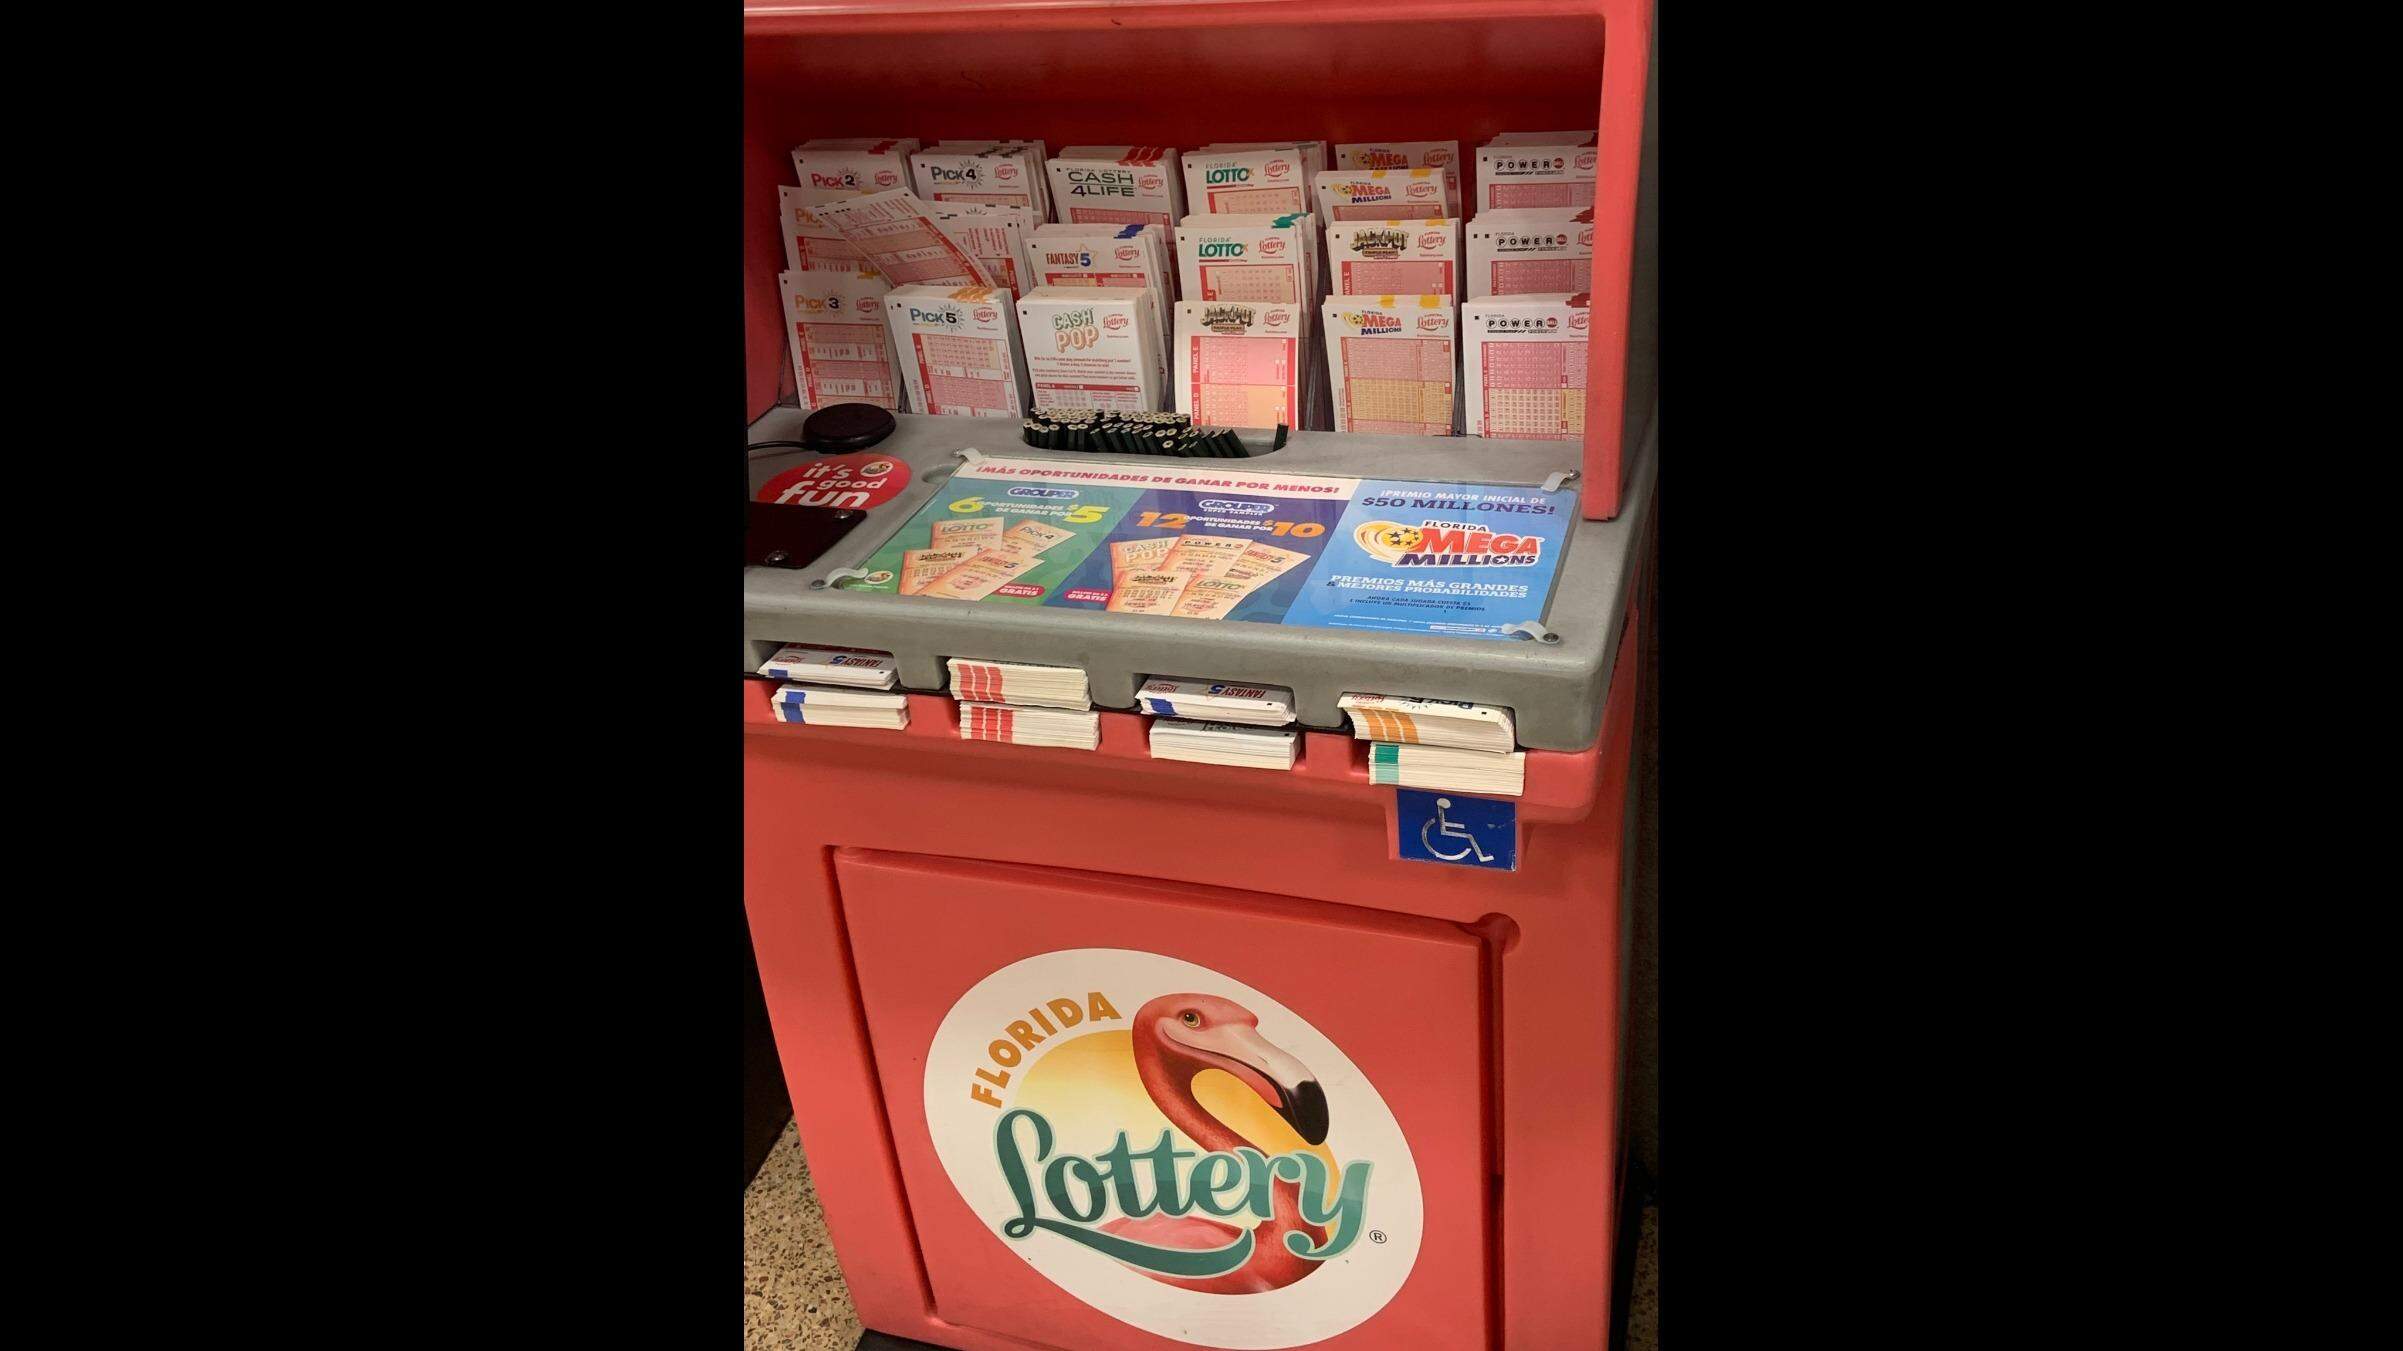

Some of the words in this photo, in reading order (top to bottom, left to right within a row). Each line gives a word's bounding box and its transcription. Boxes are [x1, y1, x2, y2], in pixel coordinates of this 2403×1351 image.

[1370, 153, 1408, 167] MEGA
[845, 175, 856, 186] 2
[965, 168, 976, 180] 4
[1068, 171, 1135, 185] CASH
[1206, 168, 1250, 184] LOTTO
[1070, 185, 1135, 198] 4LIFE
[1352, 184, 1391, 196] MEGA
[1198, 242, 1245, 258] LOTTO
[1046, 253, 1079, 265] FANTASY
[1080, 253, 1092, 267] 5
[828, 297, 839, 309] 3
[945, 312, 957, 324] 5
[1052, 308, 1095, 330] CASH
[1362, 314, 1402, 328] MEGA
[1361, 327, 1402, 336] MILLIONS
[1055, 325, 1099, 353] POP
[803, 462, 853, 479] it's
[817, 478, 888, 490] good
[1019, 468, 1148, 482] OPORTUNIDADES
[1151, 475, 1172, 483] DE
[1175, 477, 1231, 487] GANAR
[1235, 481, 1269, 489] POR
[1273, 484, 1340, 493] MENOS!
[774, 480, 871, 508] fun
[1009, 488, 1075, 498] GROUPER
[1436, 492, 1478, 501] MAYOR
[1483, 495, 1528, 504] INICIAL
[948, 496, 985, 513] 6
[1362, 497, 1406, 507] $50
[1411, 499, 1555, 515] MILLONES!
[1010, 508, 1048, 516] GANAR
[1136, 511, 1189, 529] 12
[1183, 515, 1261, 526] OPORTUNIDADES
[1424, 521, 1487, 532] FLORIDA
[942, 524, 987, 533] LOTTO
[1218, 523, 1252, 531] GANAR
[1408, 528, 1539, 555] MEGA
[1398, 553, 1536, 566] MILLIONS
[1331, 575, 1404, 587] PREMIOS
[1408, 578, 1445, 588] MÁS
[1448, 582, 1529, 592] GRANDES
[1338, 582, 1402, 592] MEJORES
[1404, 587, 1527, 598] PROBABILIDADES
[999, 588, 1039, 596] GRATIS
[831, 655, 847, 665] 5
[843, 658, 883, 668] FANTASY
[1208, 684, 1225, 695] 5
[1222, 687, 1266, 698] FANTASY
[971, 992, 1122, 1109] FLORIDA
[993, 1107, 1374, 1280] Lottery
